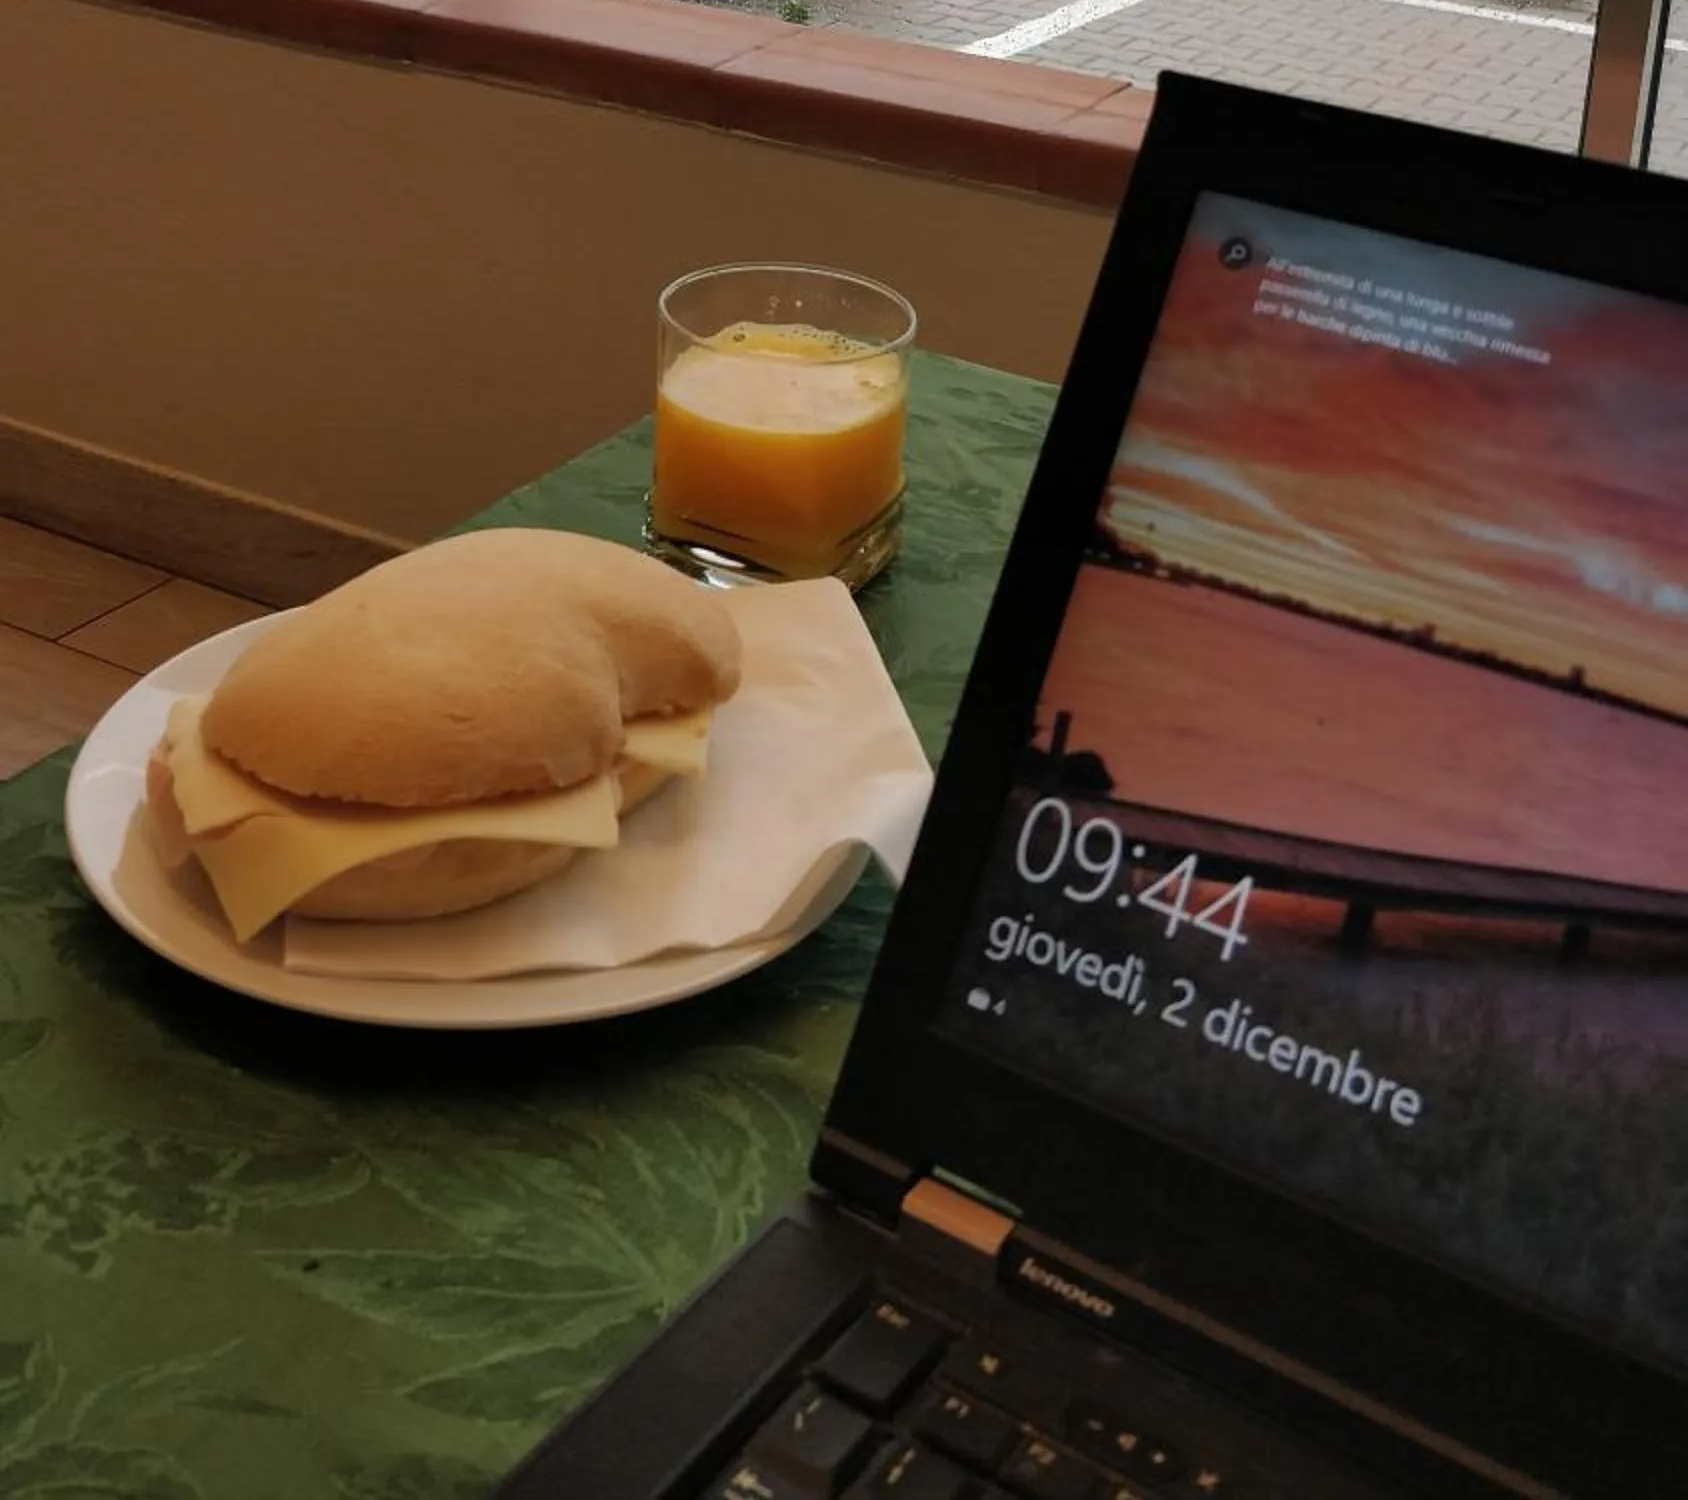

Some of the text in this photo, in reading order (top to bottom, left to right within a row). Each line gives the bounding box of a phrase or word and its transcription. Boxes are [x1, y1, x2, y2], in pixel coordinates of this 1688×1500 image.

[1015, 797, 1256, 962] 09:44
[984, 913, 1423, 1127] giovedì, 2 dicembre
[1018, 1257, 1116, 1318] lenovo
